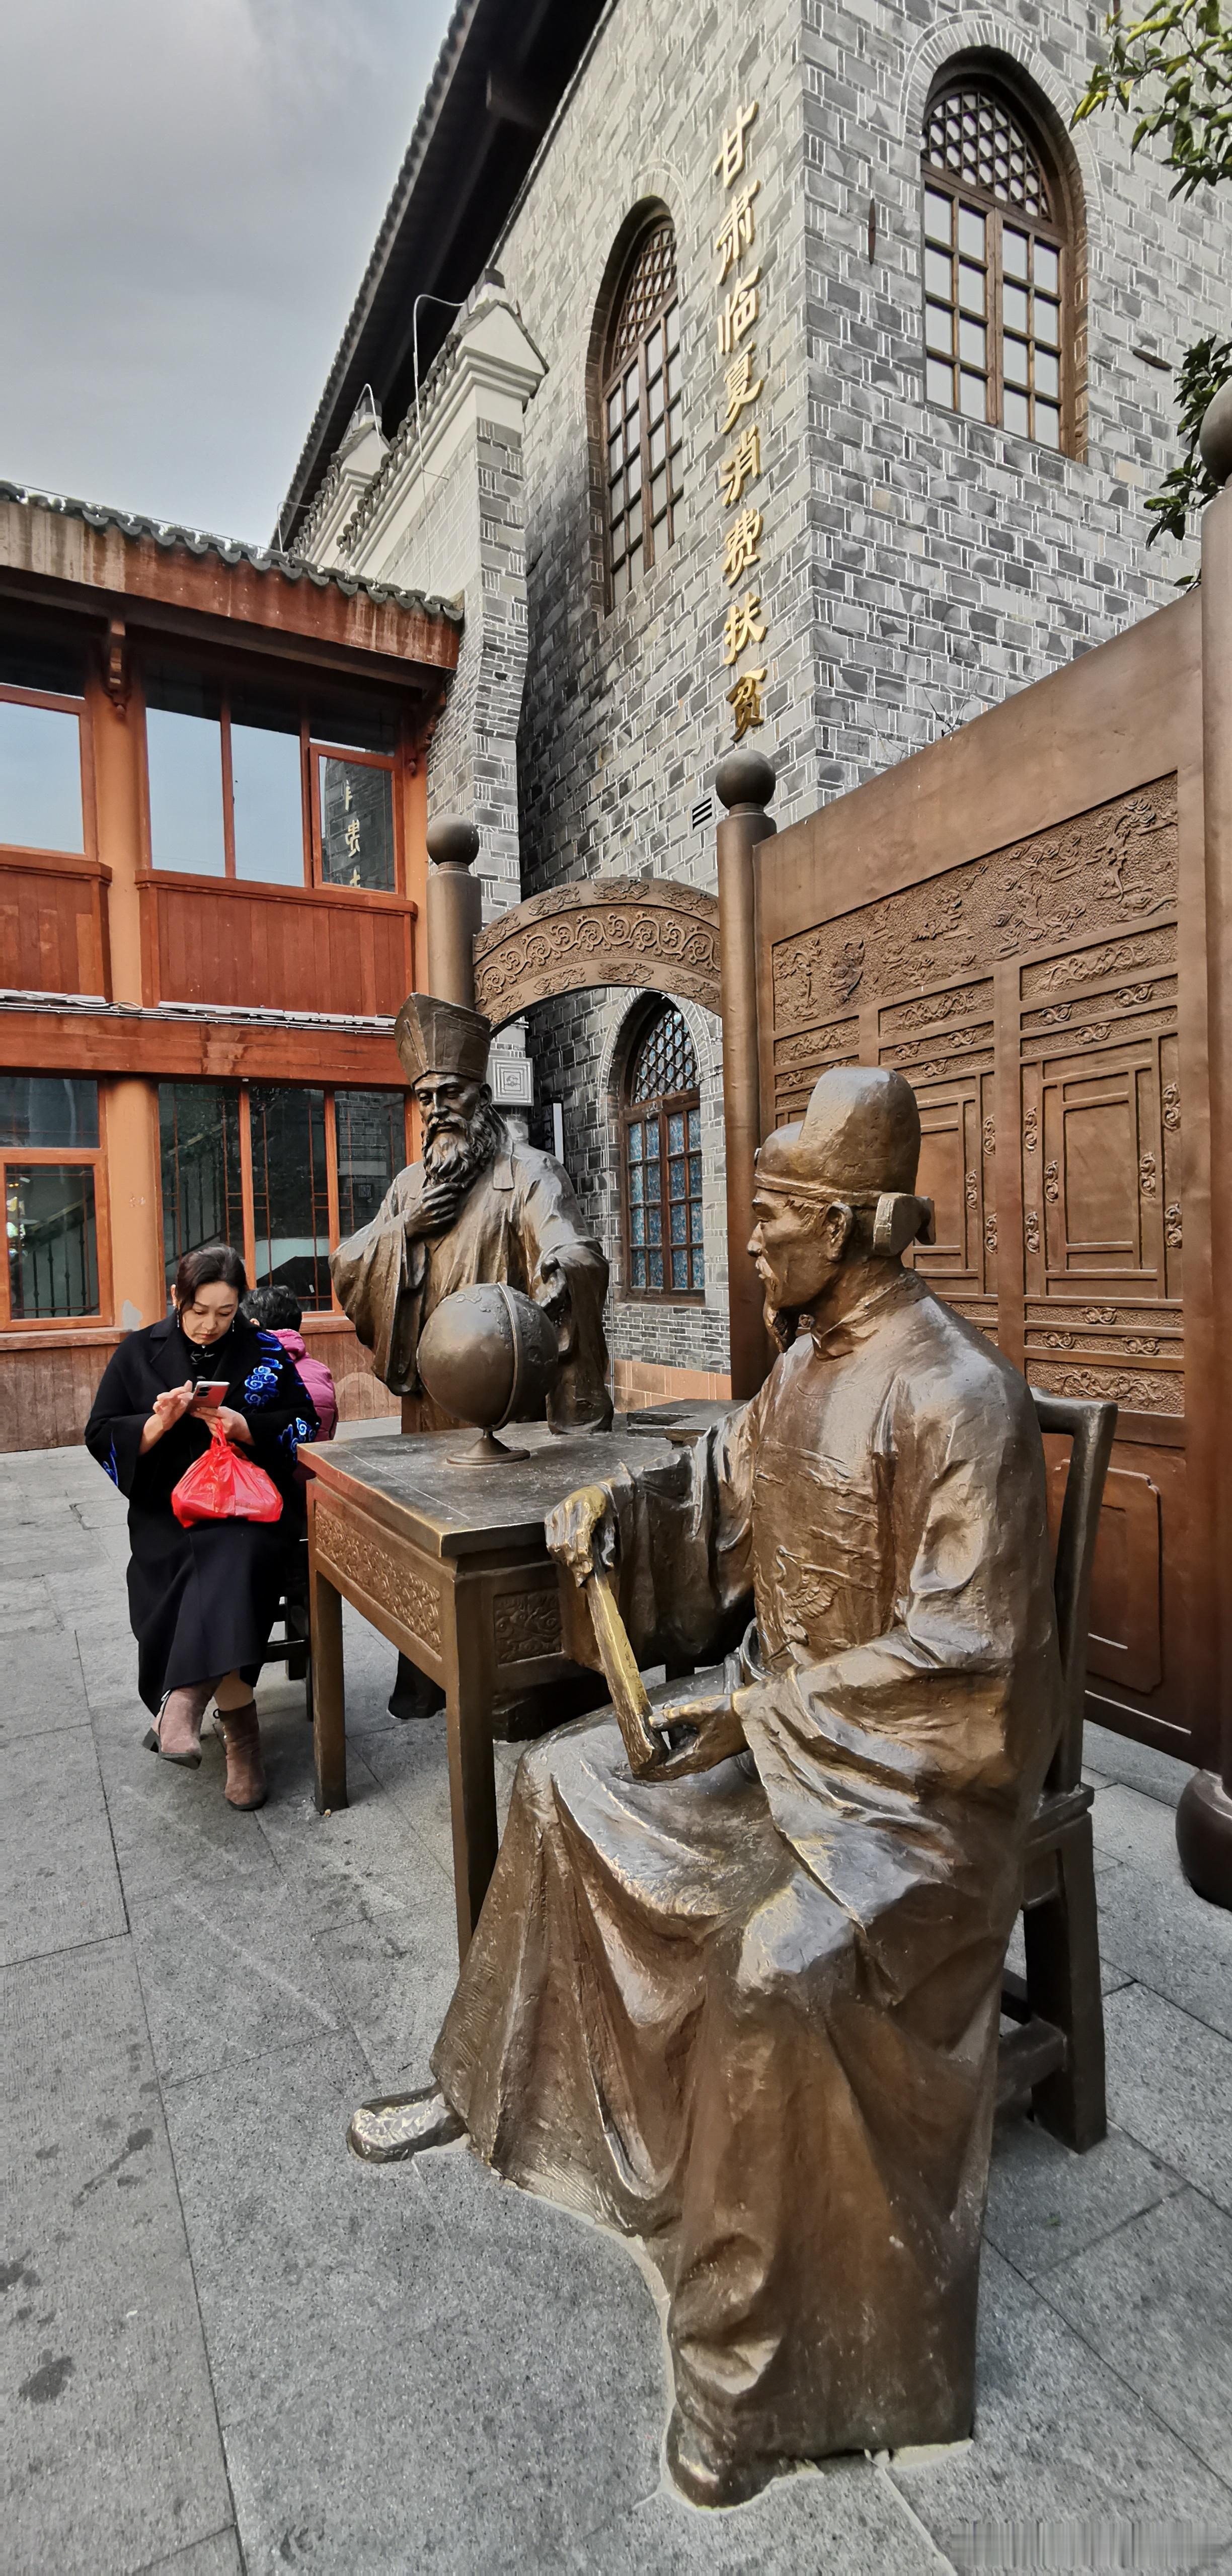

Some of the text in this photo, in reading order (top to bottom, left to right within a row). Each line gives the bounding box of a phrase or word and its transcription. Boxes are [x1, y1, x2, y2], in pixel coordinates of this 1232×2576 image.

[713, 102, 768, 741] 甘肃临夏消费扶贫
